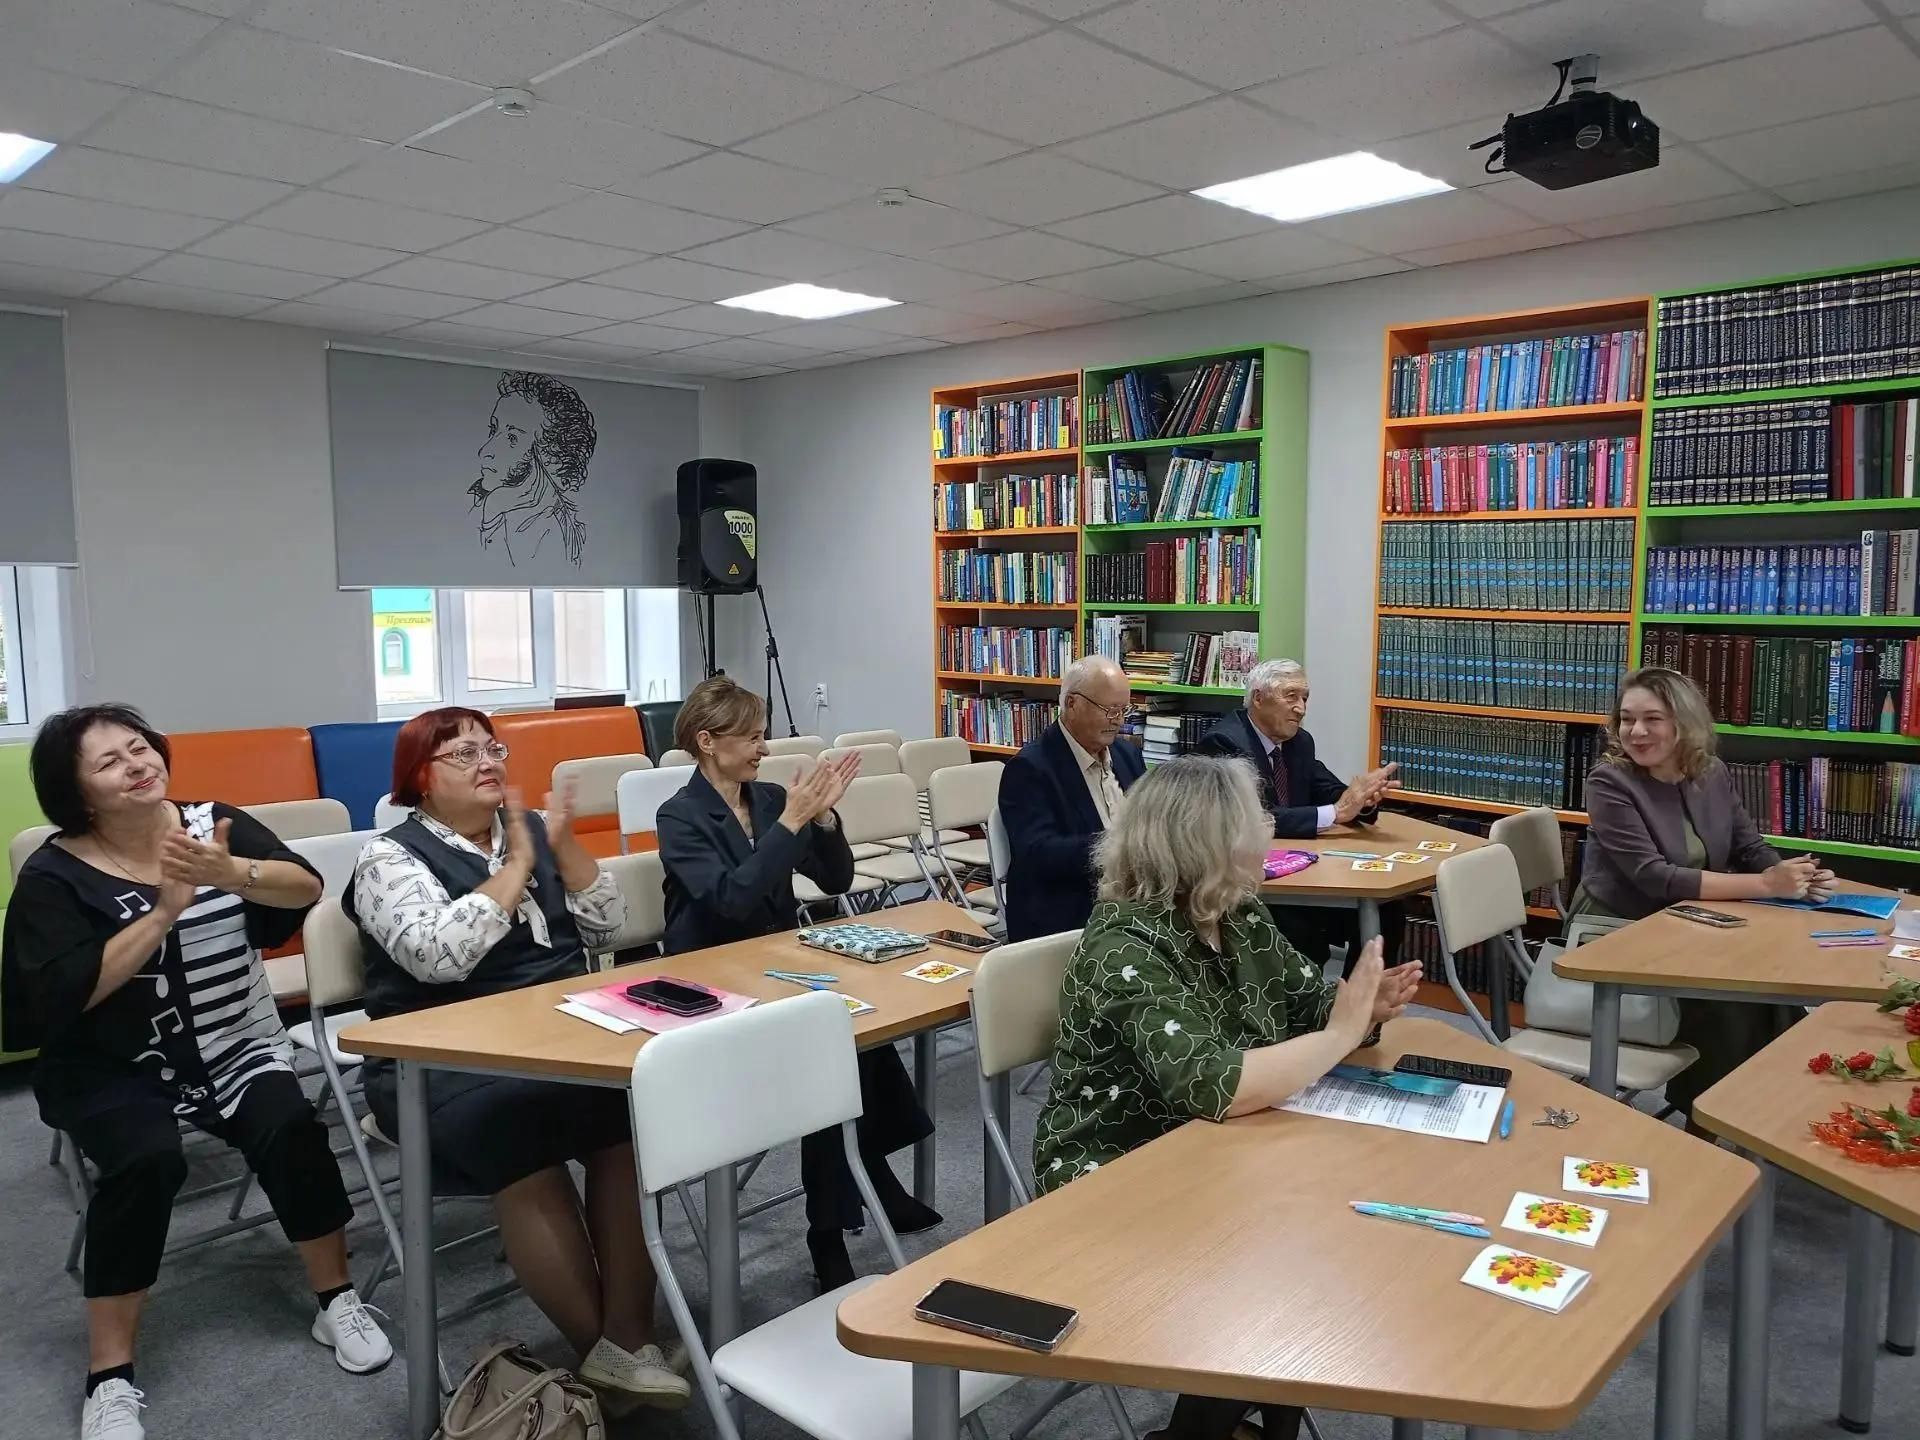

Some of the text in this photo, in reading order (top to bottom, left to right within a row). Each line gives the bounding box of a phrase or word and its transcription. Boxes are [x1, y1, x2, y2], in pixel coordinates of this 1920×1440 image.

[729, 521, 753, 534] 1000
[1828, 661, 1840, 693] ЛУЧШЕ
[1878, 652, 1887, 680] Учебный
